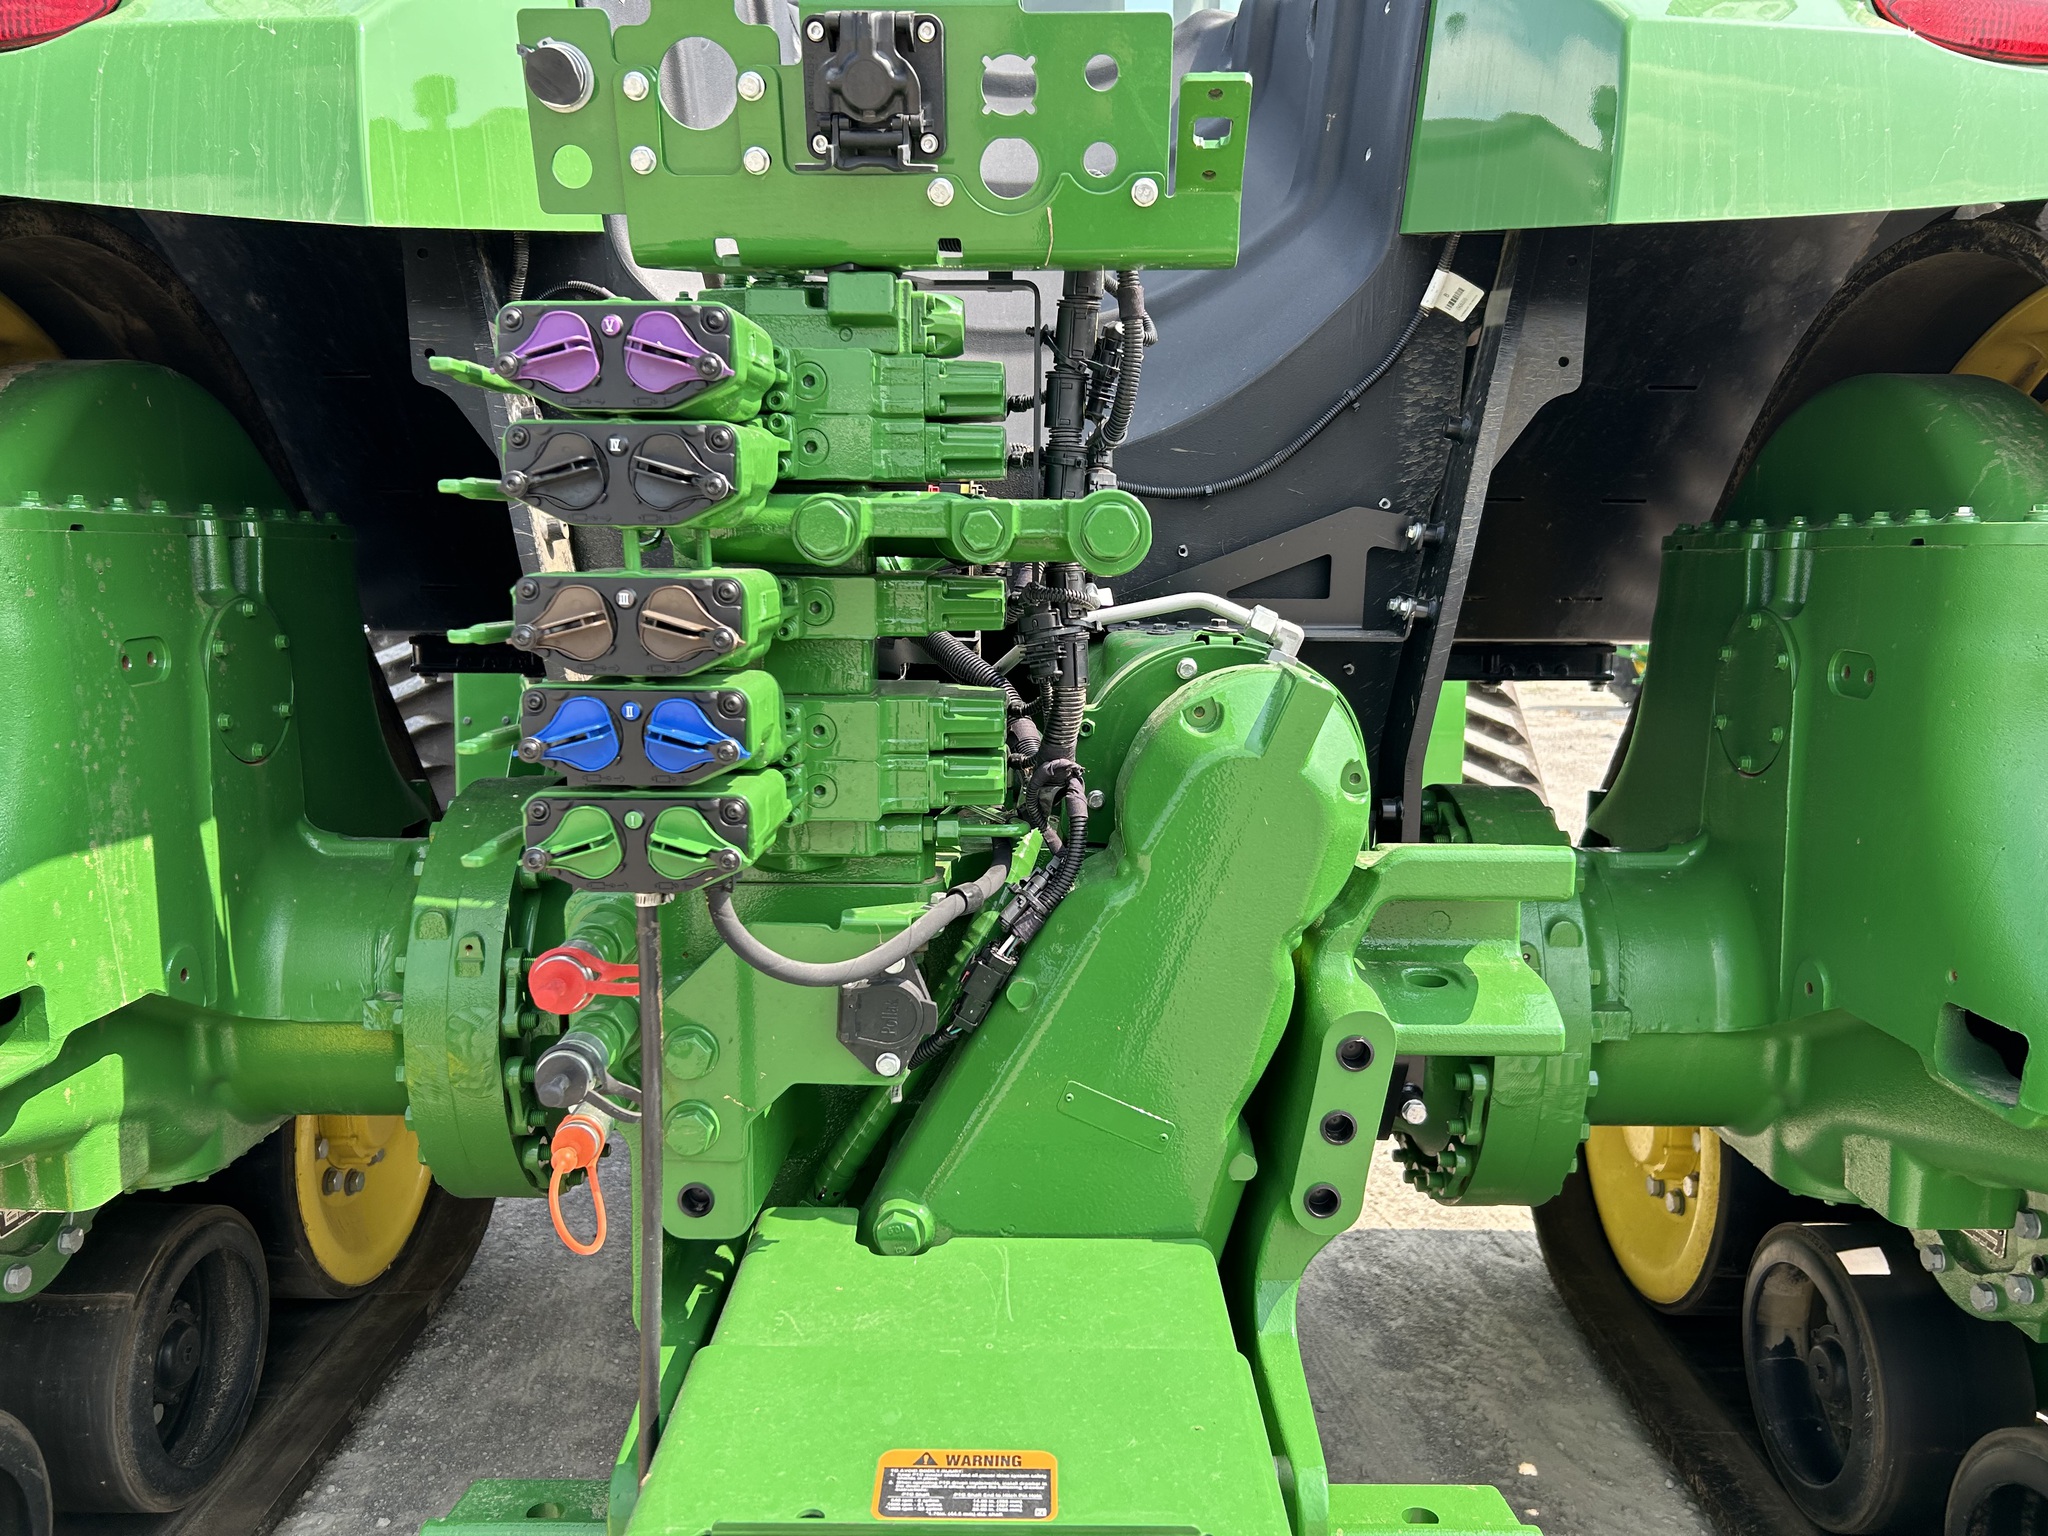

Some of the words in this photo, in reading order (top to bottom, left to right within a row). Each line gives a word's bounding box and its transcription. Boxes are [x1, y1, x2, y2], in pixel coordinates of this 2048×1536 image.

[605, 321, 615, 332] V
[610, 438, 621, 451] IV
[619, 592, 630, 605] III
[625, 706, 634, 717] II
[880, 999, 899, 1037] Pollak
[946, 1454, 1022, 1467] WARNING
